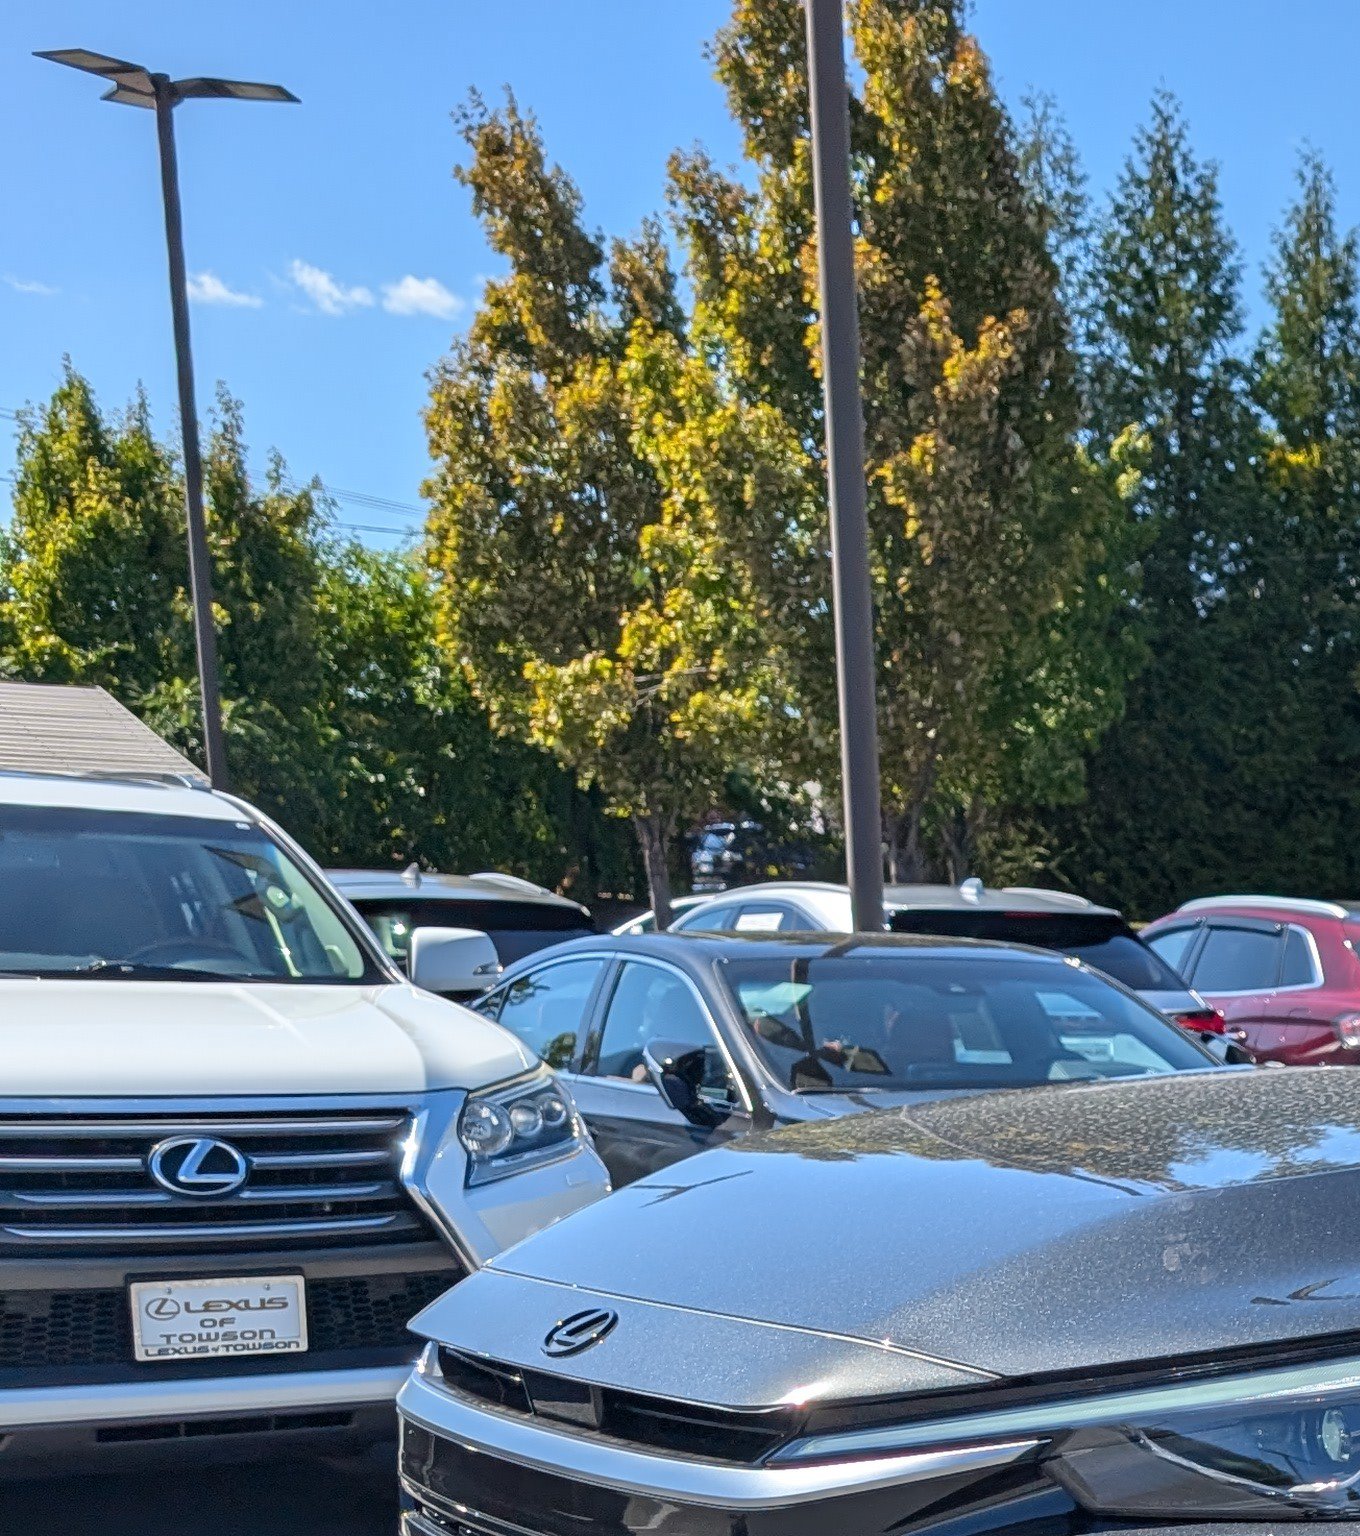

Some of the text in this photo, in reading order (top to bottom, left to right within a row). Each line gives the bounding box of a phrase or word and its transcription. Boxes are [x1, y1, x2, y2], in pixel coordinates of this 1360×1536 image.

[184, 1297, 289, 1313] LEXUS
[199, 1317, 236, 1328] OF
[160, 1329, 276, 1344] TOWSON
[145, 1345, 209, 1357] LEXUS
[221, 1340, 300, 1353] TOWSON
